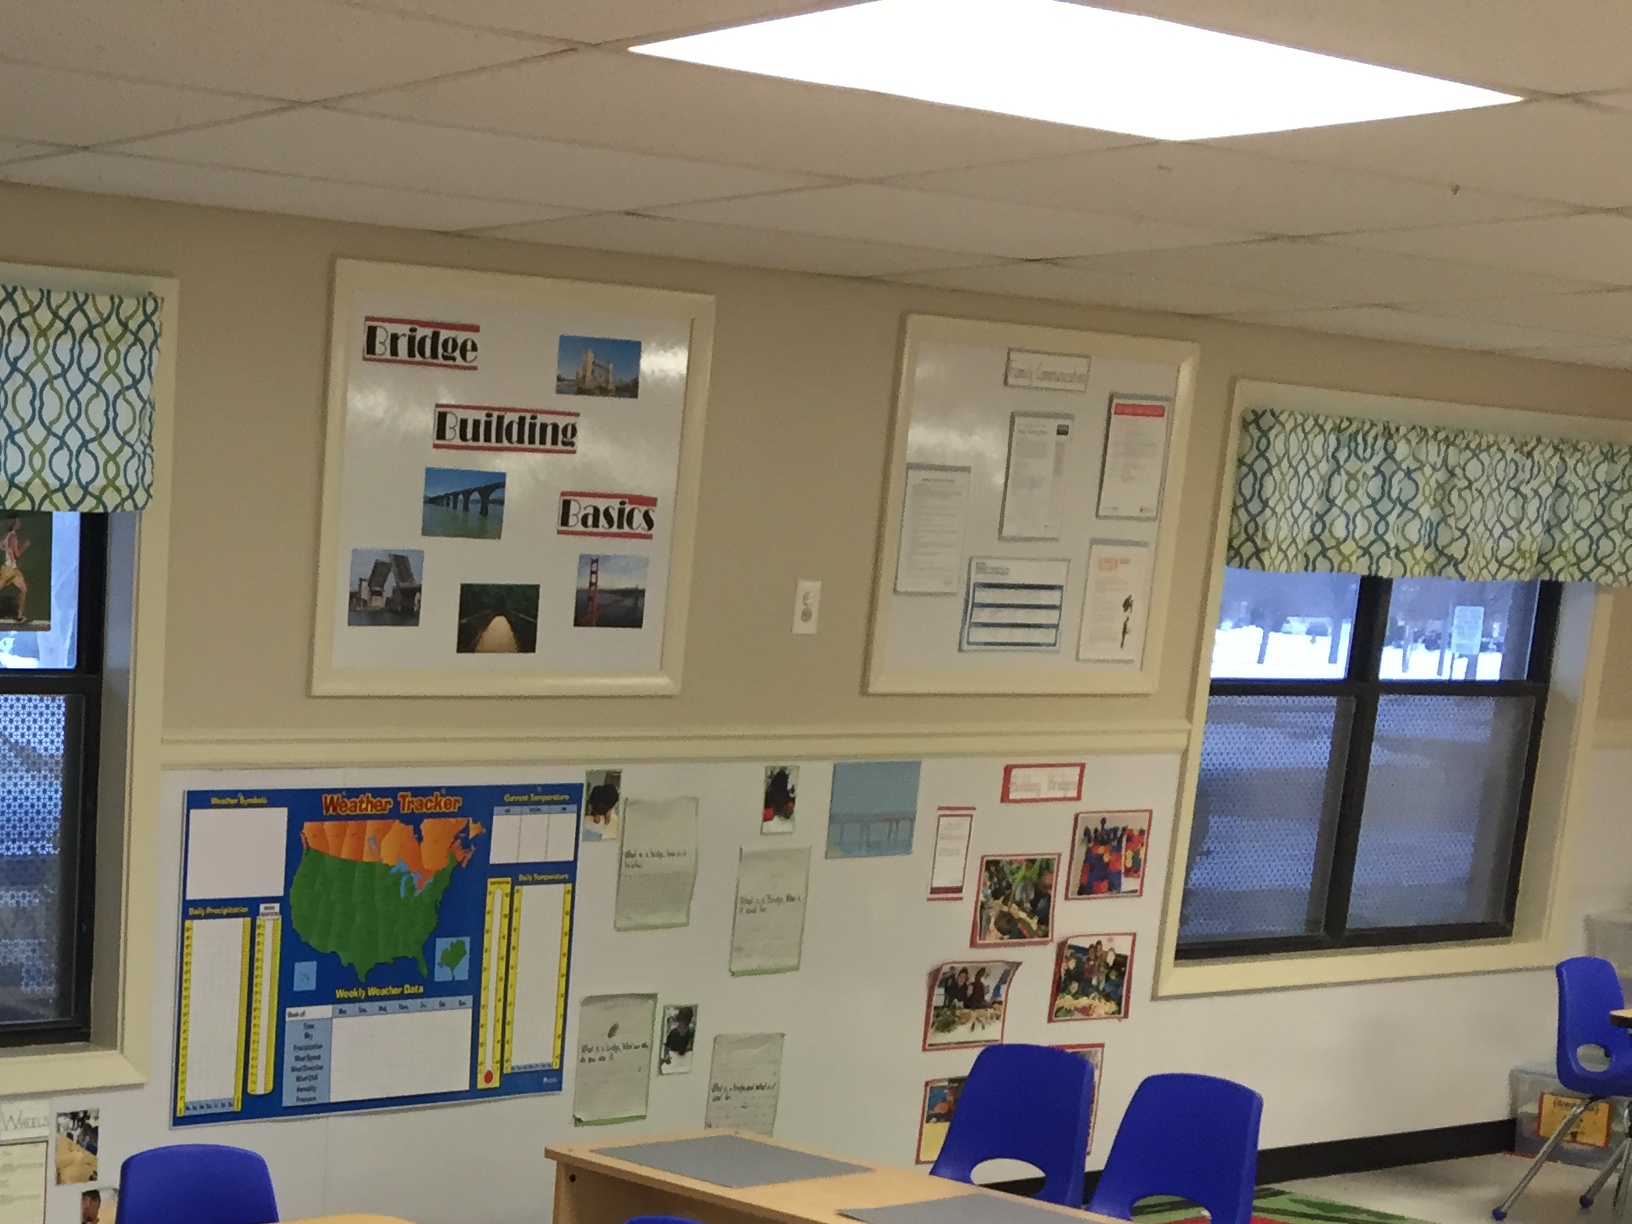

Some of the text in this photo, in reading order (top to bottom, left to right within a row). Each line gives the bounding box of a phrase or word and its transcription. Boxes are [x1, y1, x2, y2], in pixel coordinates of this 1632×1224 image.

[366, 324, 479, 363] Bridge
[436, 411, 578, 447] Building
[560, 499, 655, 532] Basics
[322, 791, 462, 815] Weather Tracker
[335, 984, 424, 1000] Weekly Weather Data
[1, 1109, 49, 1131] WHEELS
